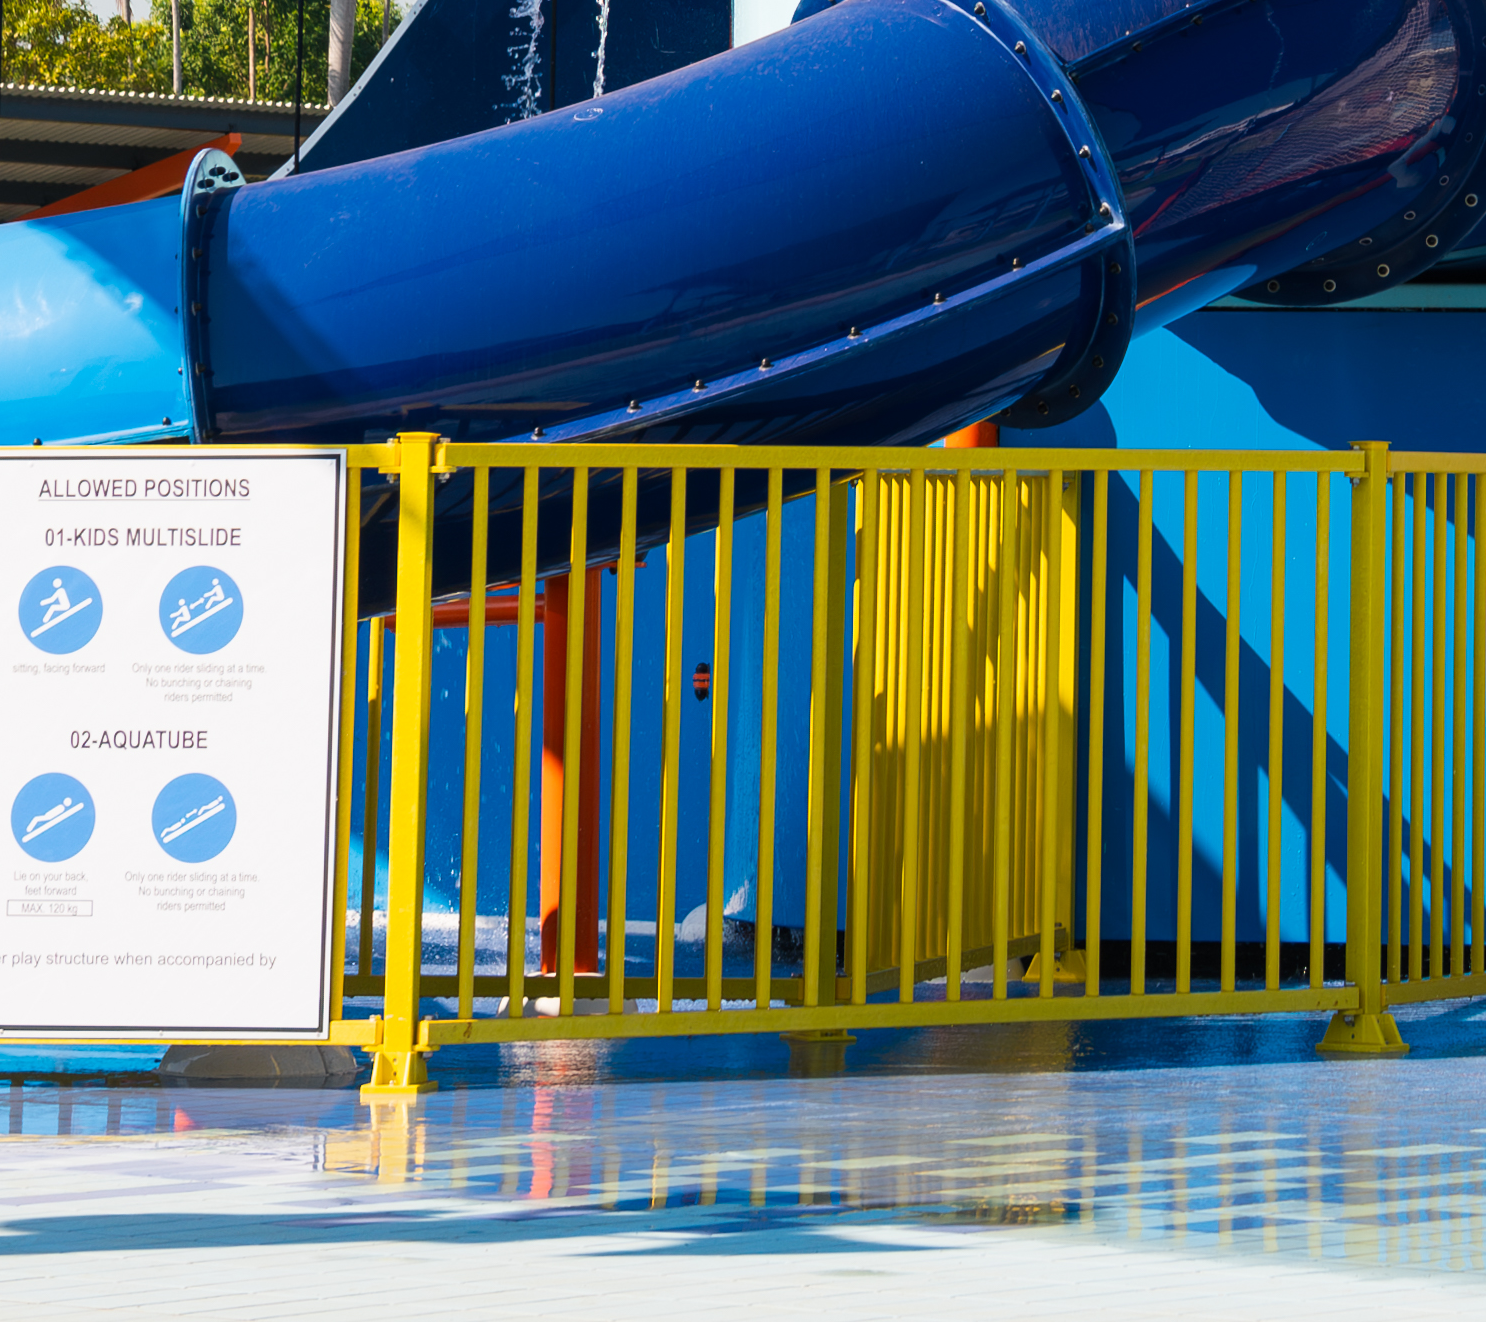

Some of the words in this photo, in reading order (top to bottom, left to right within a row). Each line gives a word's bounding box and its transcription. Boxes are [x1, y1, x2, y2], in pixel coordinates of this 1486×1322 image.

[38, 479, 137, 497] ALLOWED
[144, 479, 250, 497] POSITIONS
[45, 528, 119, 546] 01-KIDS
[126, 528, 241, 546] MULTISLIDE
[43, 662, 71, 675] facing
[72, 662, 106, 673] forward
[131, 662, 153, 675] Only
[154, 664, 172, 673] one
[173, 663, 195, 673] rider
[195, 663, 225, 675] sliding
[226, 663, 236, 673] at
[237, 664, 244, 673] a
[145, 676, 159, 687] No
[160, 677, 202, 690] bunching
[203, 679, 213, 687] or
[214, 677, 253, 690] chaining
[163, 691, 189, 702] riders
[191, 691, 233, 703] permitted
[70, 730, 208, 749] 02-AQUATUBE
[13, 870, 28, 881] Lie
[28, 872, 41, 881] on
[42, 872, 63, 883] your
[124, 870, 146, 884] Only
[147, 873, 165, 881] one
[166, 871, 187, 881] rider
[189, 872, 218, 884] sliding
[219, 872, 229, 882] at
[230, 873, 237, 882] a
[24, 884, 42, 895] feet
[43, 884, 77, 895] forward
[138, 885, 152, 896] No
[153, 885, 195, 899] bunching
[195, 888, 206, 896] or
[207, 885, 246, 899] chaining
[156, 900, 182, 911] riders
[183, 900, 226, 912] permitted
[11, 951, 42, 968] play
[45, 953, 109, 965] structure
[113, 953, 153, 965] when
[157, 953, 255, 969] accompanied
[259, 953, 277, 969] by
